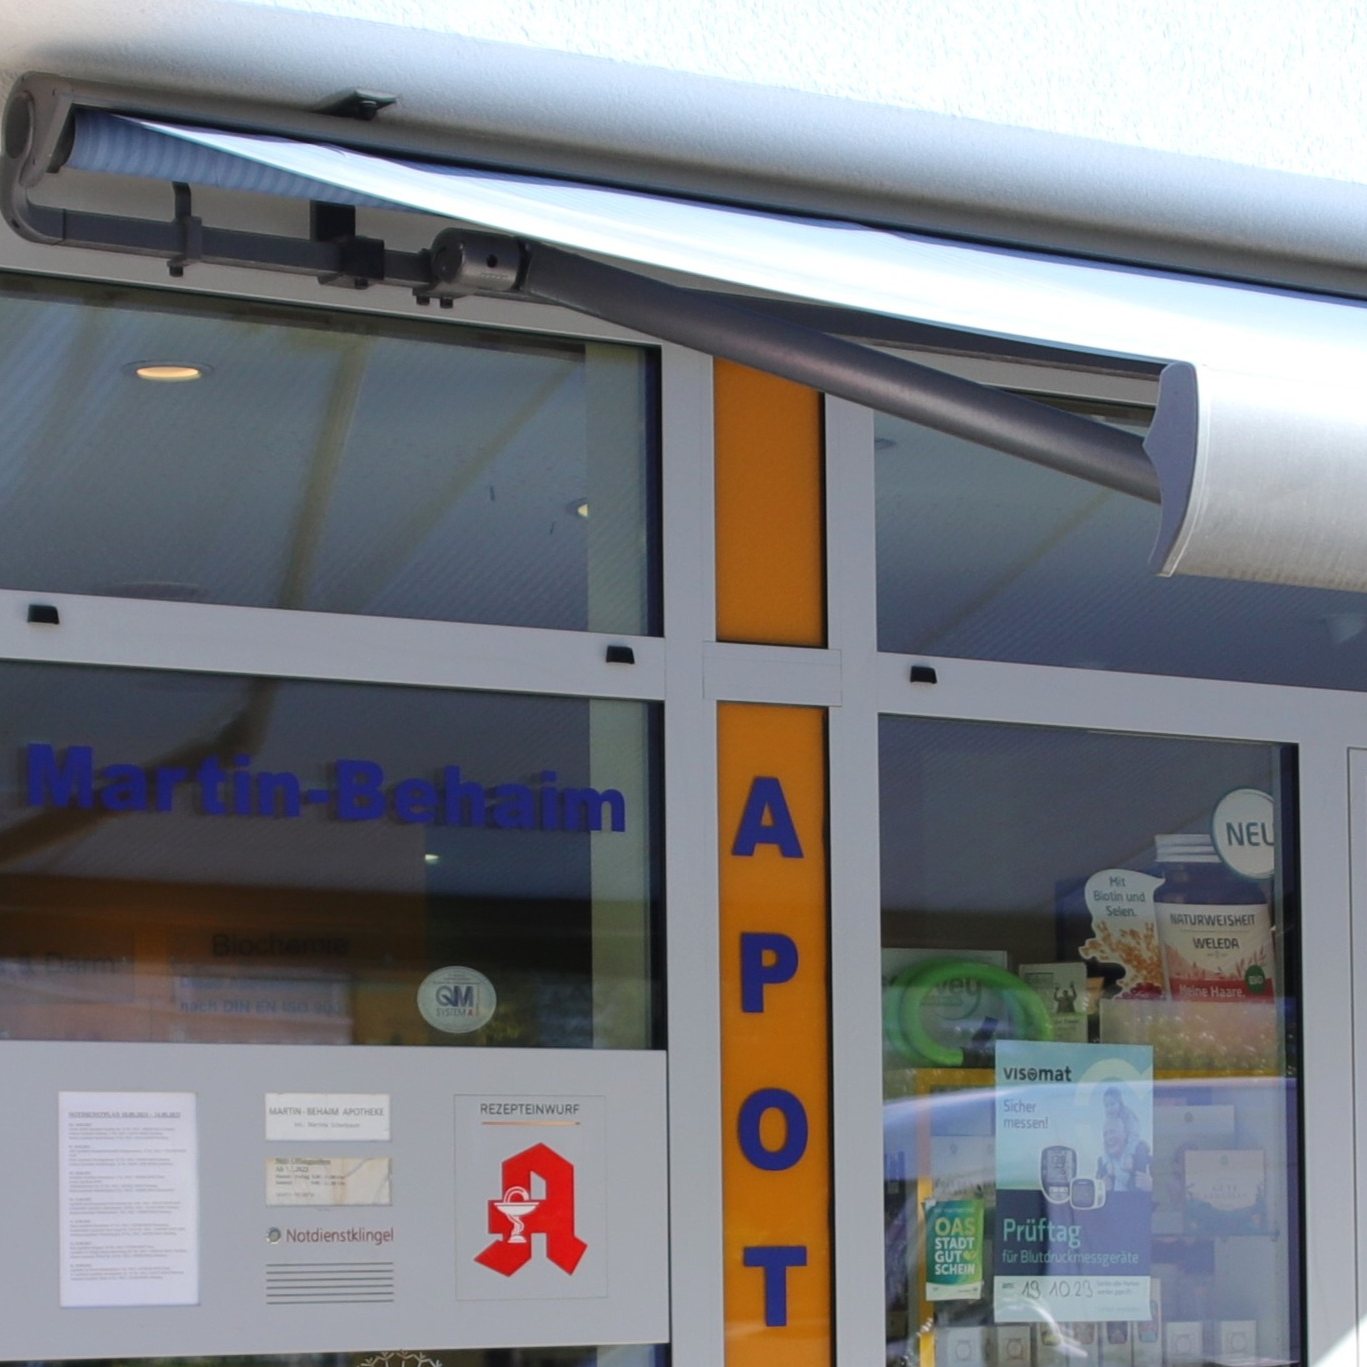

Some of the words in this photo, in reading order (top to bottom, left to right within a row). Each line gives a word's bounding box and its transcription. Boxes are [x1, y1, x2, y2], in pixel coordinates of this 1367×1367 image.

[26, 744, 626, 832] Martin-Behaim
[1109, 877, 1126, 887] Mit
[1094, 891, 1123, 902] Biotin
[1127, 891, 1145, 902] und
[1106, 906, 1137, 917] Selen.
[1170, 914, 1255, 926] NATURWEISHEIT
[1193, 937, 1239, 949] WELEDA
[1211, 986, 1245, 998] Haare.
[1003, 1066, 1072, 1082] visomat
[269, 1107, 302, 1117] MARTIN
[307, 1107, 339, 1117] BEHAIM
[342, 1107, 384, 1117] APOTHEKE
[479, 1102, 580, 1116] REZEPTEINWURF
[1003, 1099, 1037, 1113] Sicher
[1003, 1117, 1048, 1129] messen!
[935, 1217, 975, 1236] OAS
[1003, 1217, 1081, 1249] Prüftag
[285, 1226, 394, 1246] Notdienstklingel
[935, 1237, 975, 1250] STADT
[935, 1250, 962, 1263] GUT
[1002, 1249, 1018, 1263] für
[1020, 1249, 1139, 1267] Blutdruckmessgeräte
[935, 1263, 975, 1276] SCHEIN
